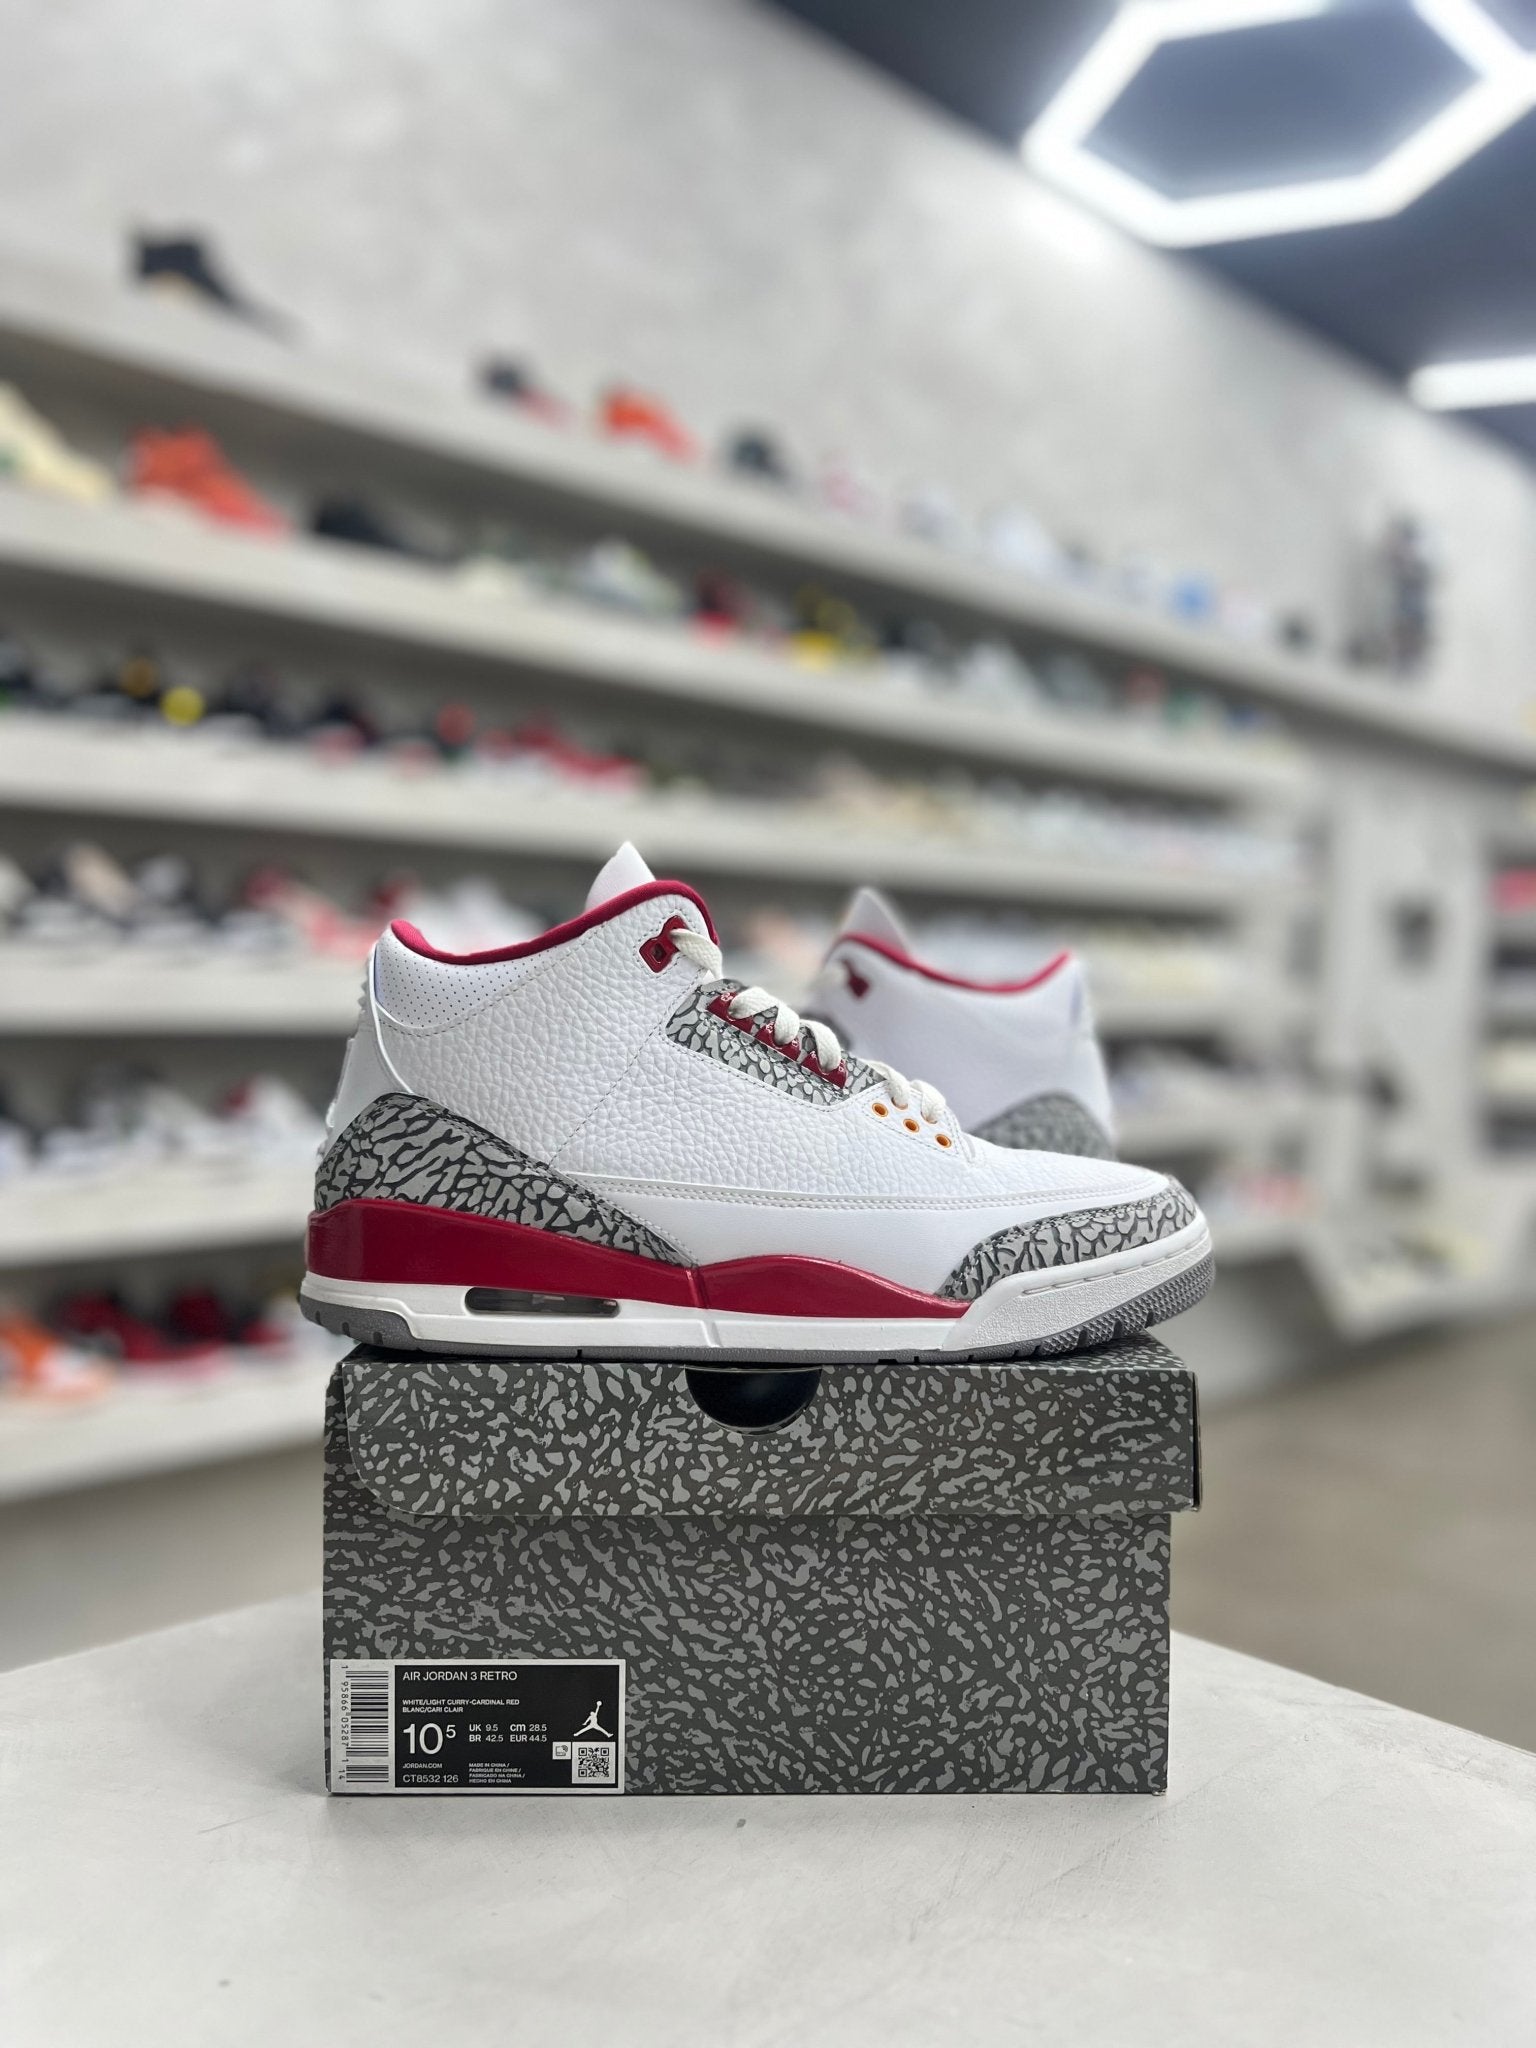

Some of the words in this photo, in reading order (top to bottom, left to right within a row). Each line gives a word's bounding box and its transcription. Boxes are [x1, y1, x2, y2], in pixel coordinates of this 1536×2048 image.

[403, 1672, 420, 1680] AIR
[423, 1672, 468, 1680] JORDAN
[470, 1672, 477, 1680] 3
[480, 1672, 517, 1680] RETRO
[339, 1770, 345, 1780] 14
